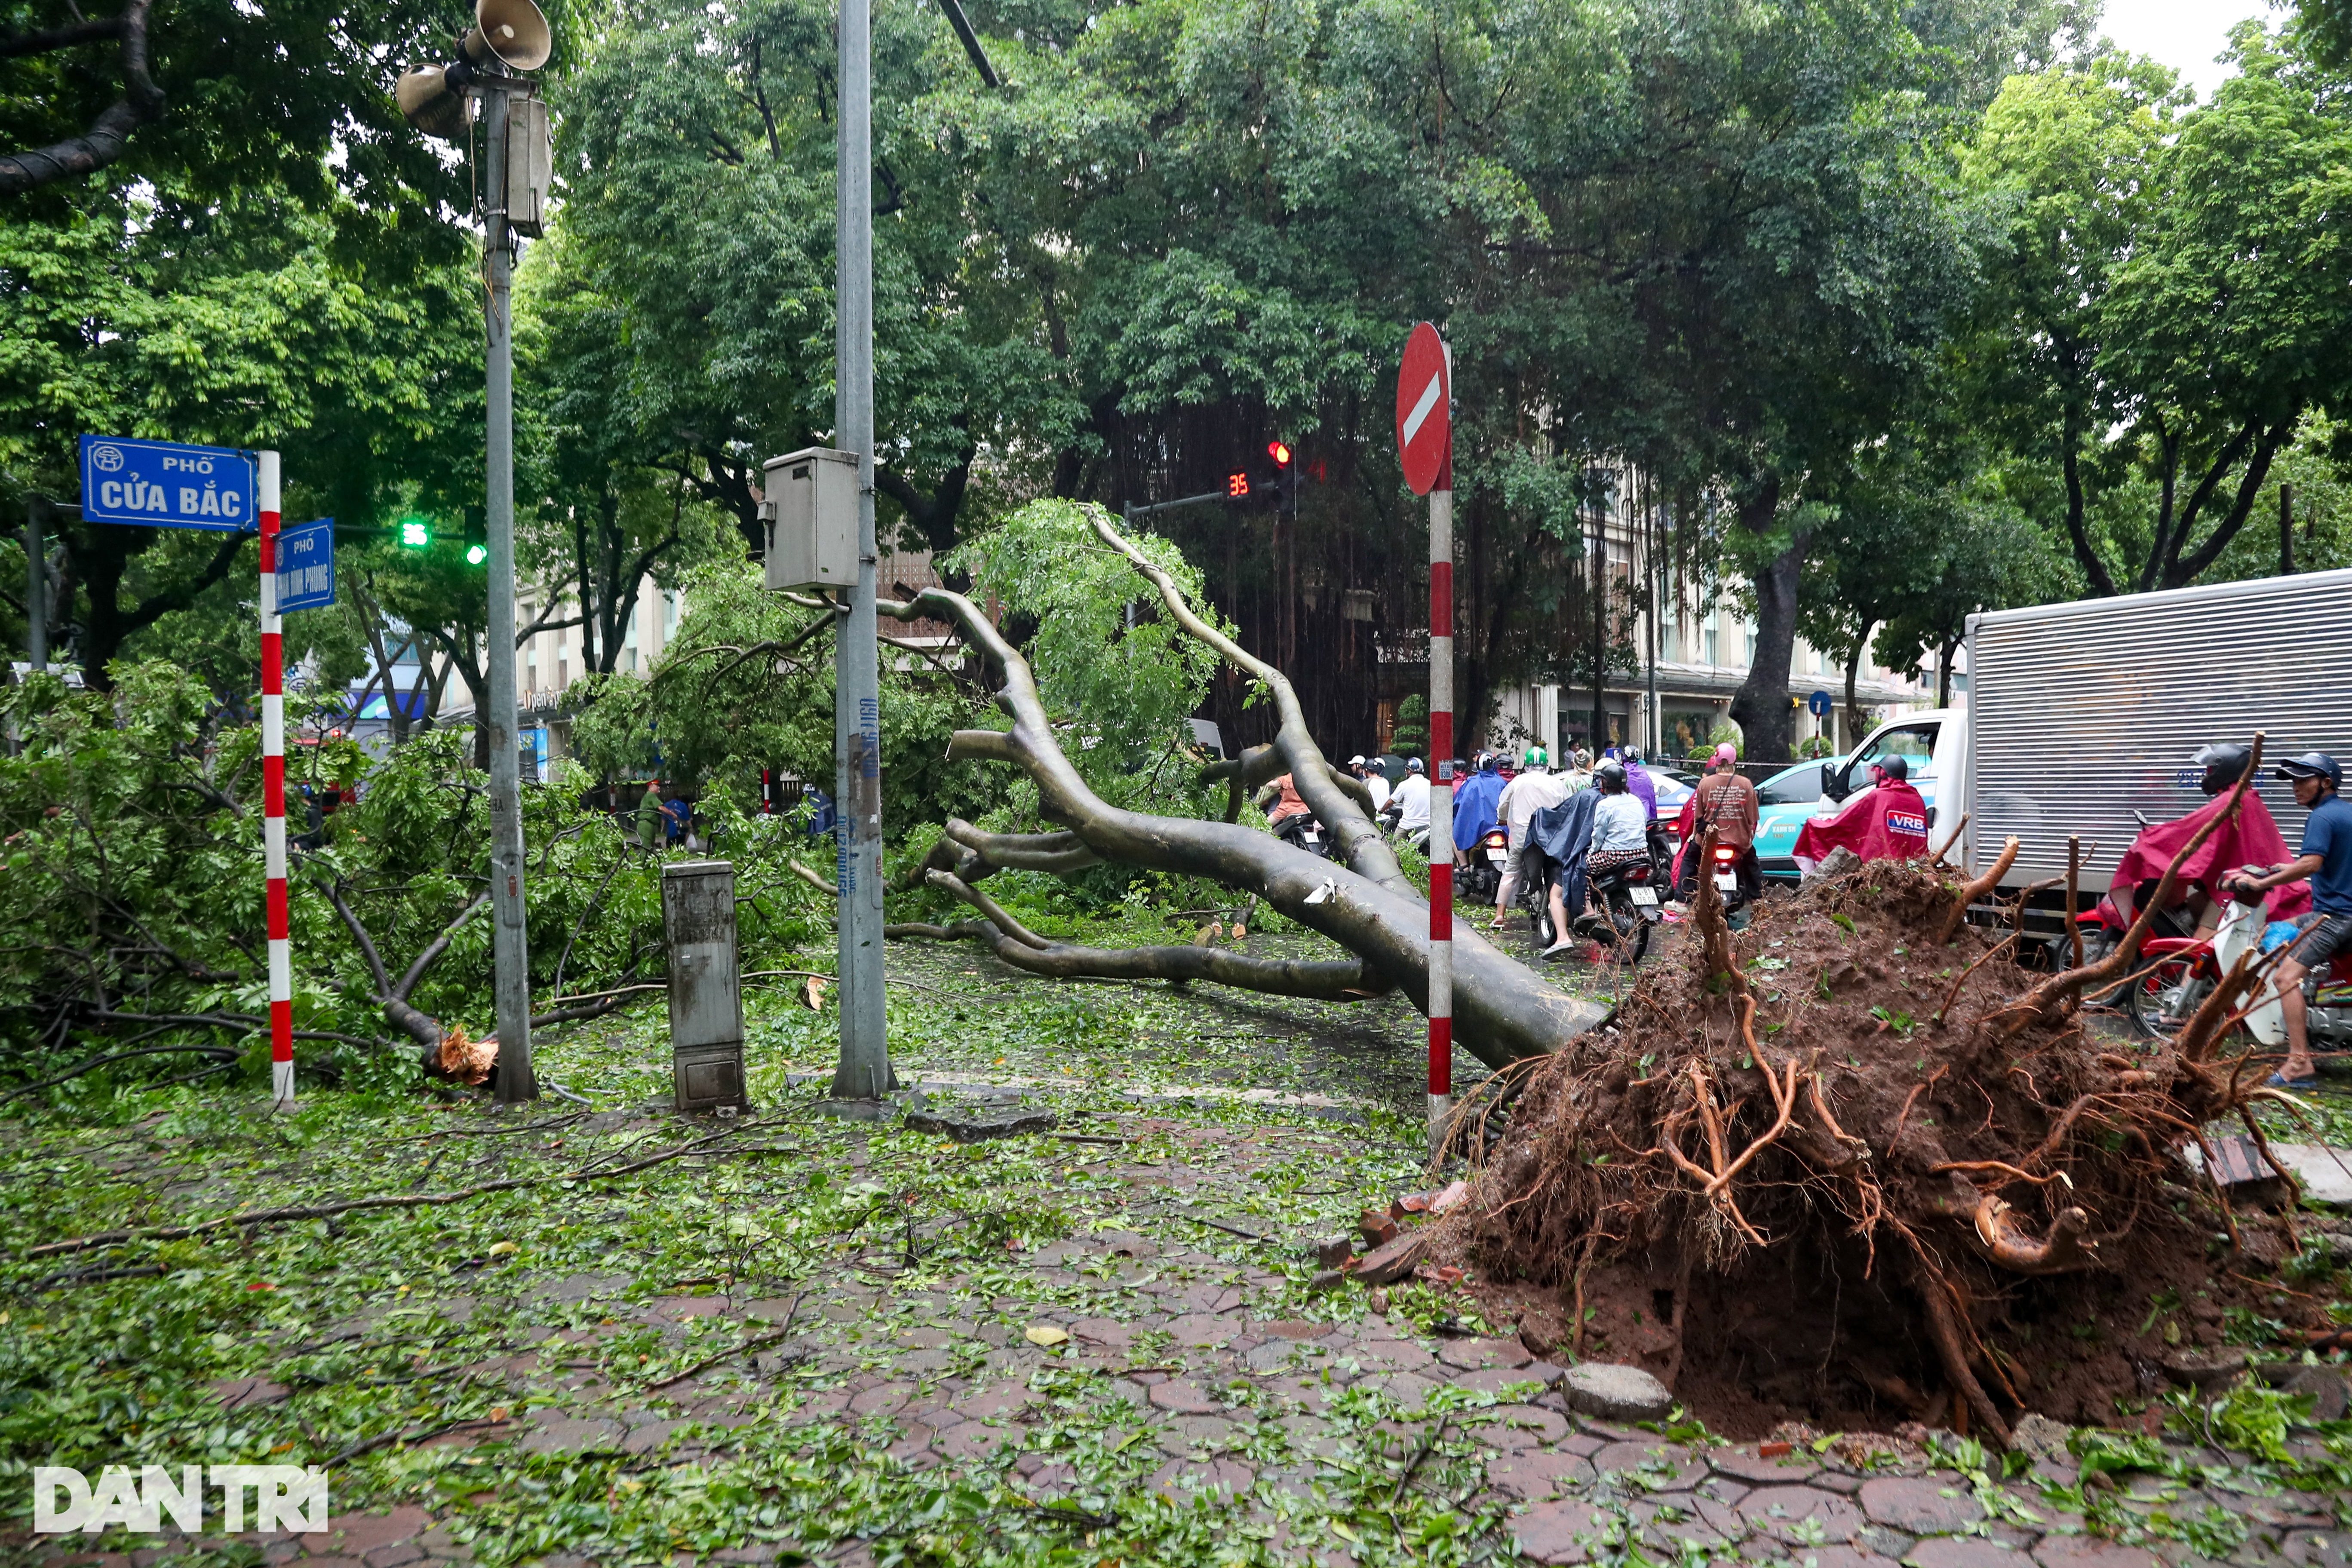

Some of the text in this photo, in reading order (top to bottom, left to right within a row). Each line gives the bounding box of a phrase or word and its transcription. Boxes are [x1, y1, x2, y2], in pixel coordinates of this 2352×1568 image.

[163, 456, 215, 475] PHỐ
[101, 471, 241, 517] CỬA BẮC
[1229, 473, 1249, 496] 35
[294, 531, 314, 554] PHỐ
[305, 559, 328, 595] PHÙNG
[1894, 814, 1924, 829] VRB
[1635, 896, 1657, 905] 476.08
